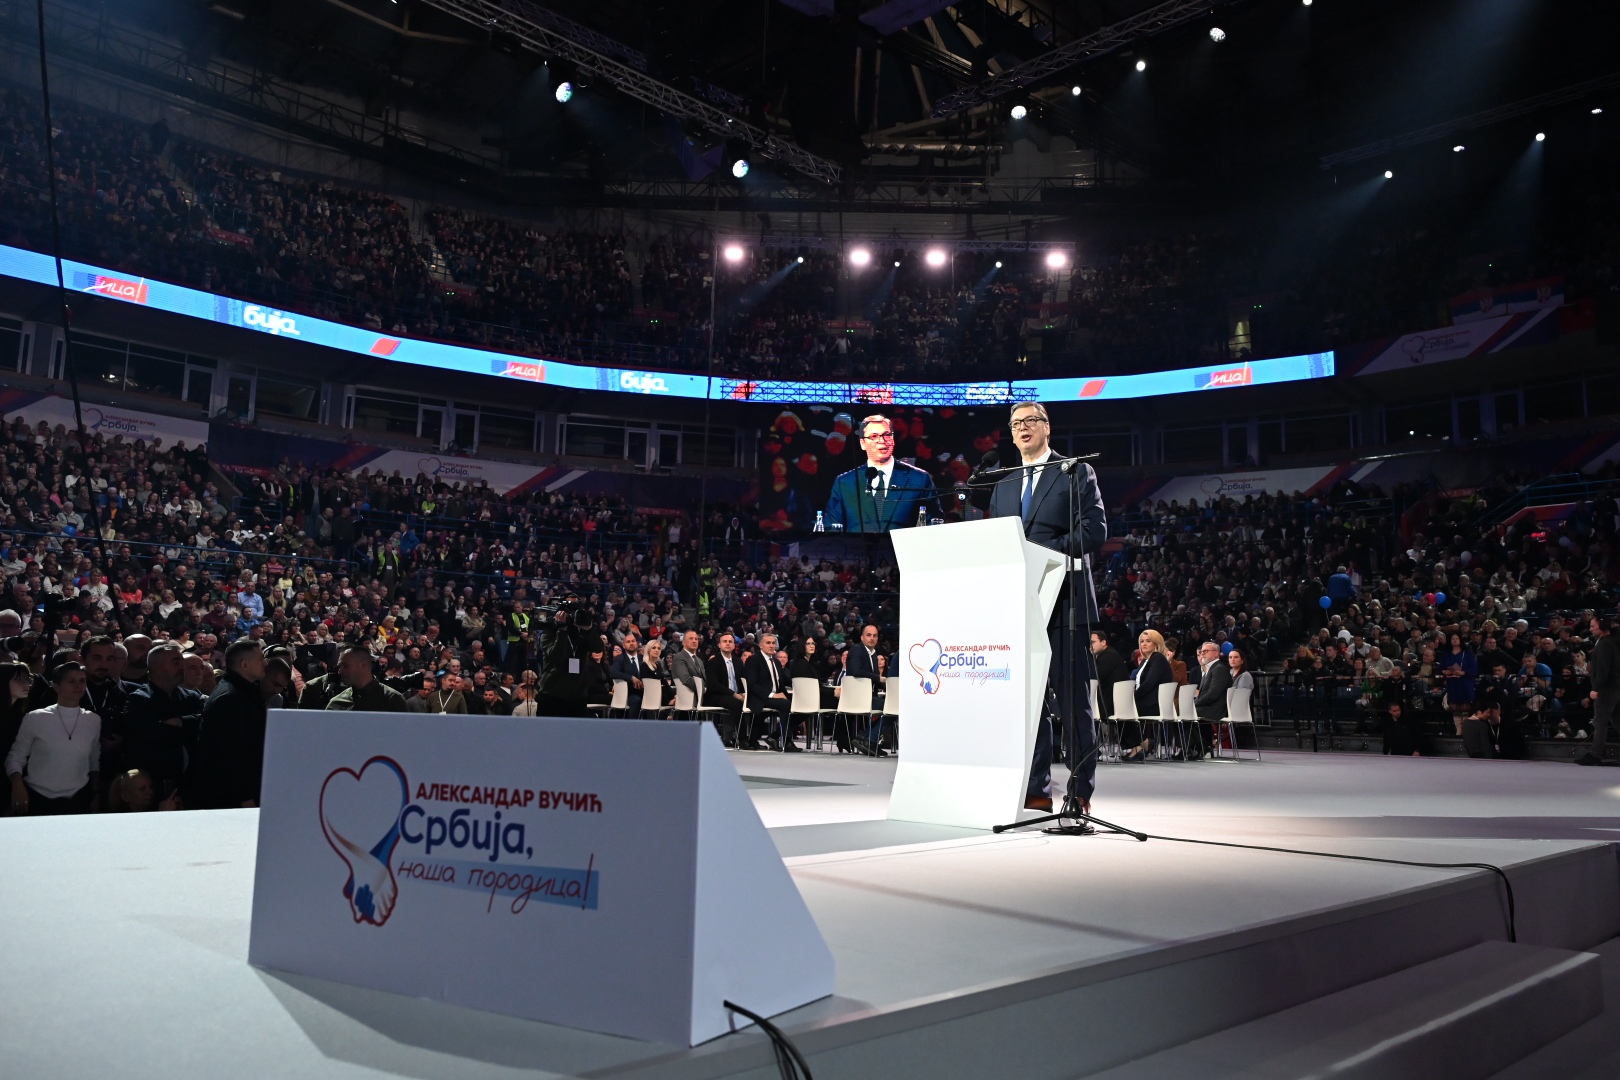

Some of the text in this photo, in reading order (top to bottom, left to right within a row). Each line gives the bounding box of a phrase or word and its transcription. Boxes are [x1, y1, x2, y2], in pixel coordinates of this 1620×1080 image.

[939, 653, 988, 669] Србија,
[964, 663, 1008, 685] породица!
[416, 782, 603, 813] АЛЕКСАНДАР ВУЧИЋ
[400, 804, 533, 862] Србија,
[398, 853, 594, 914] наша породица!
